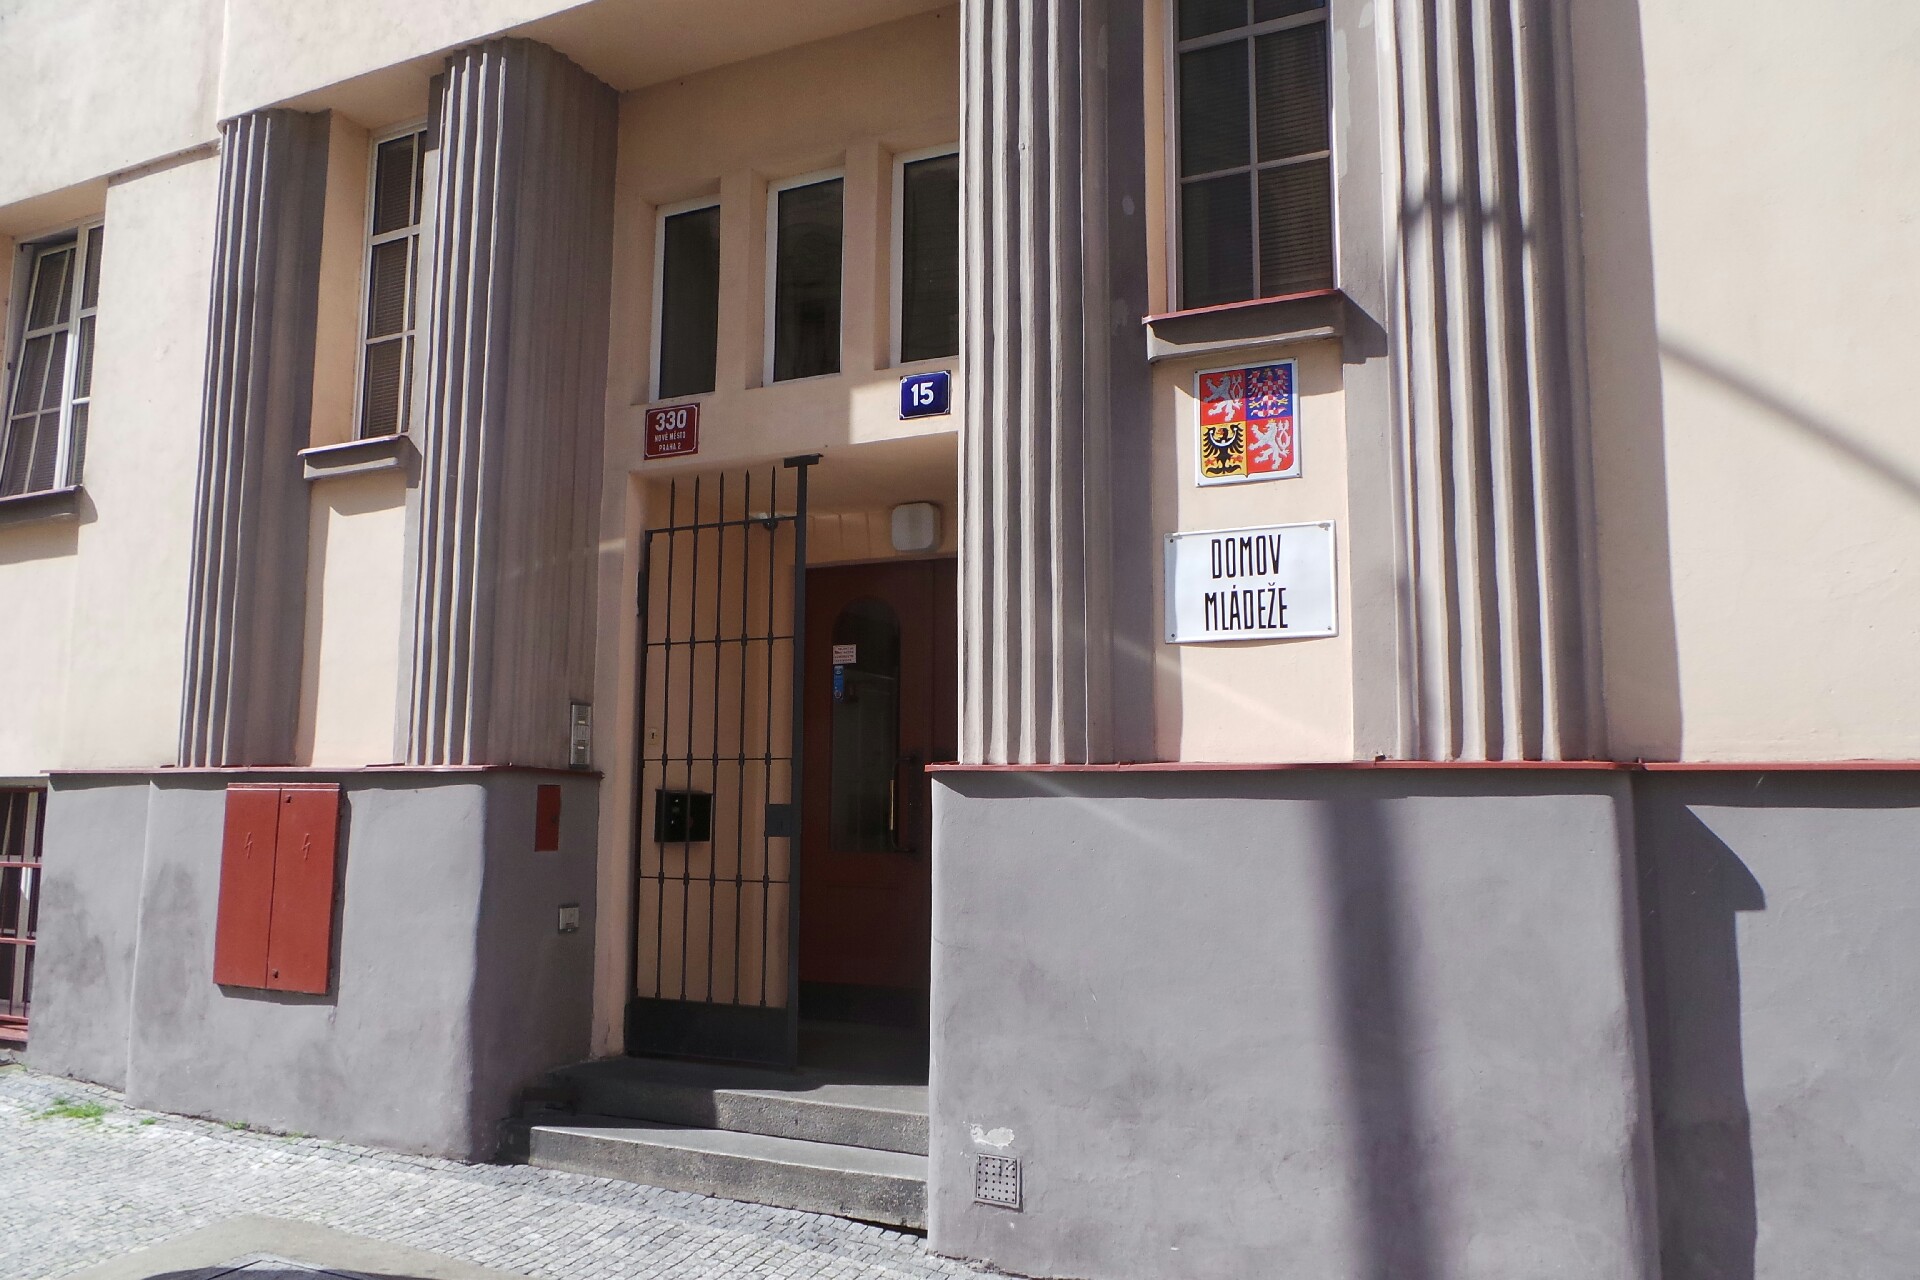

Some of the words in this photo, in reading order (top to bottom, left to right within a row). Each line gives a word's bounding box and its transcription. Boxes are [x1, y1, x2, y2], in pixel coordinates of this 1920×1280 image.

[911, 382, 934, 406] 15
[655, 410, 687, 431] 330
[659, 443, 677, 451] PRAHA
[1211, 534, 1281, 579] DOMOV
[1204, 582, 1288, 631] MLÁDEŽE
